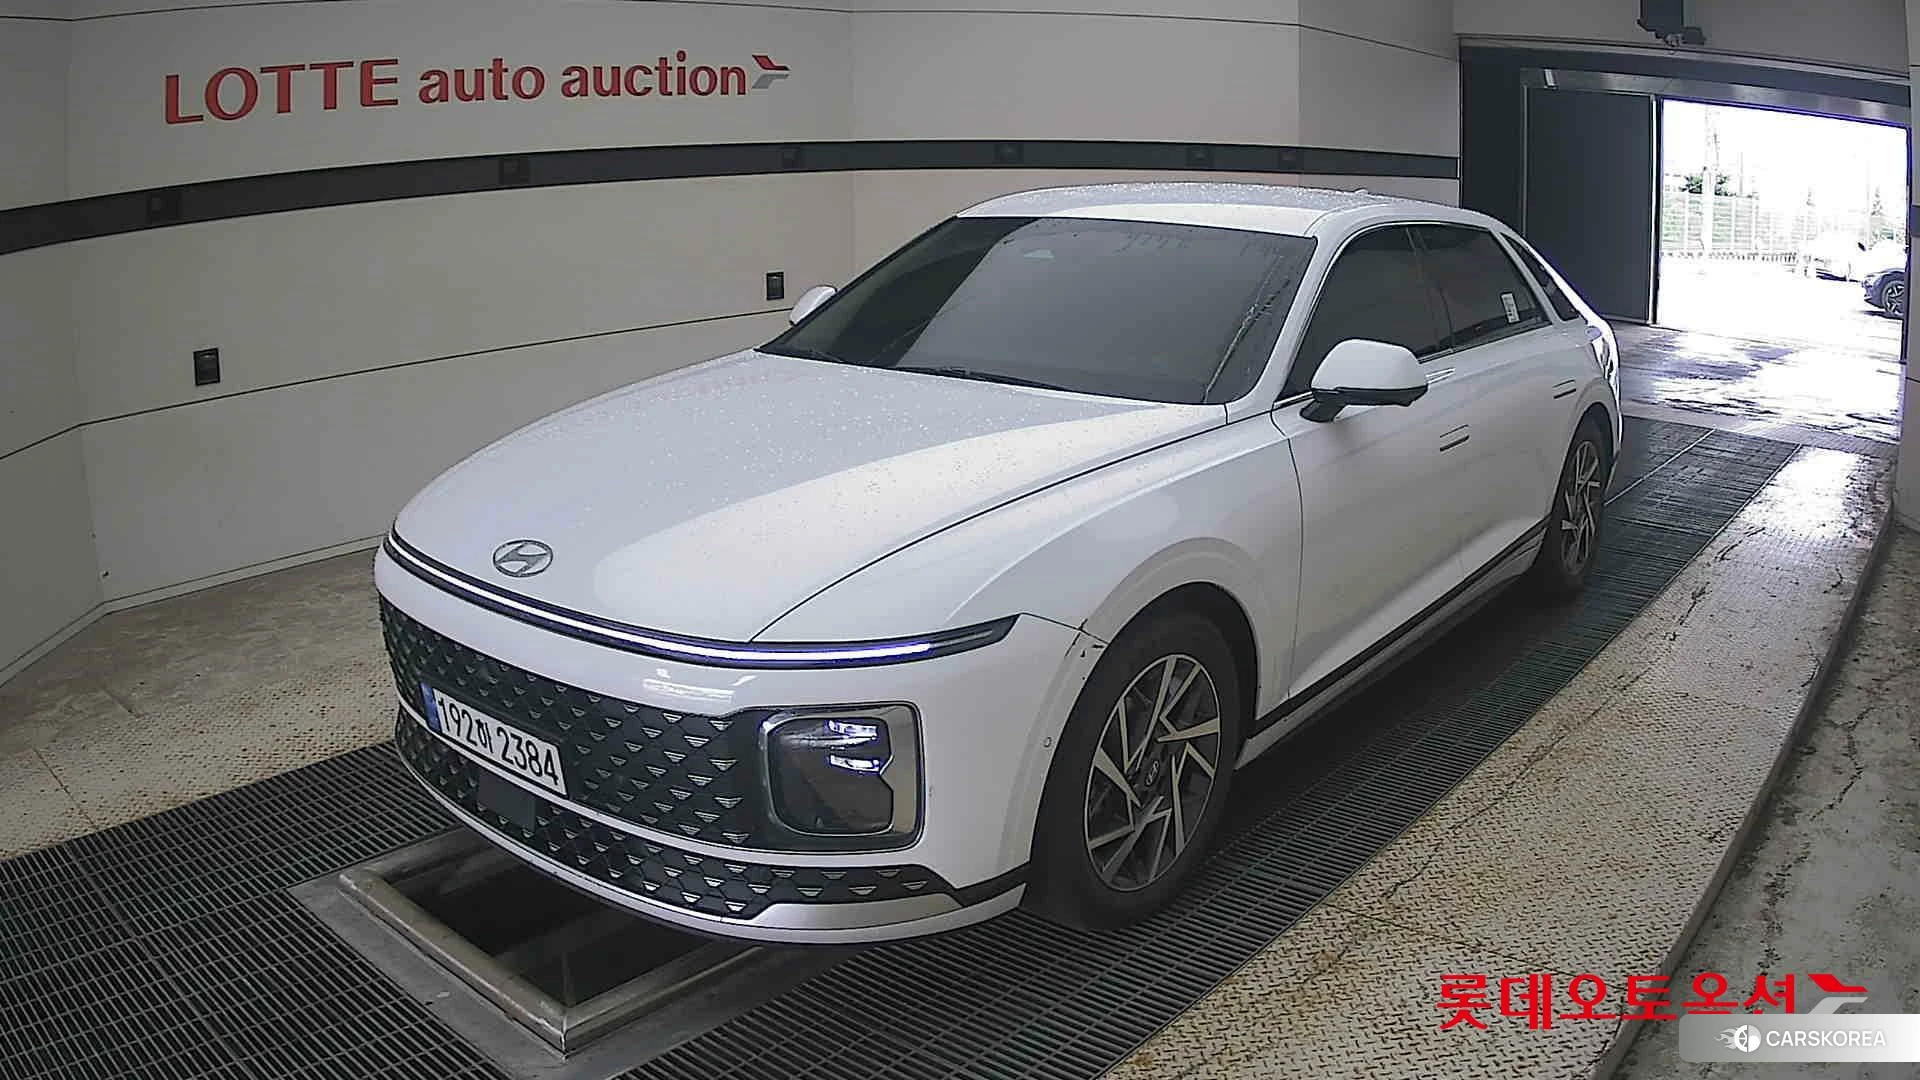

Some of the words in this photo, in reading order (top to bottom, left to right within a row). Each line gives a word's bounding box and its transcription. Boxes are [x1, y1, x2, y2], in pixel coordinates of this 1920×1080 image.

[165, 58, 399, 125] LOTTE
[418, 56, 546, 104] auto
[560, 49, 747, 99] auction
[496, 726, 560, 786] 2384
